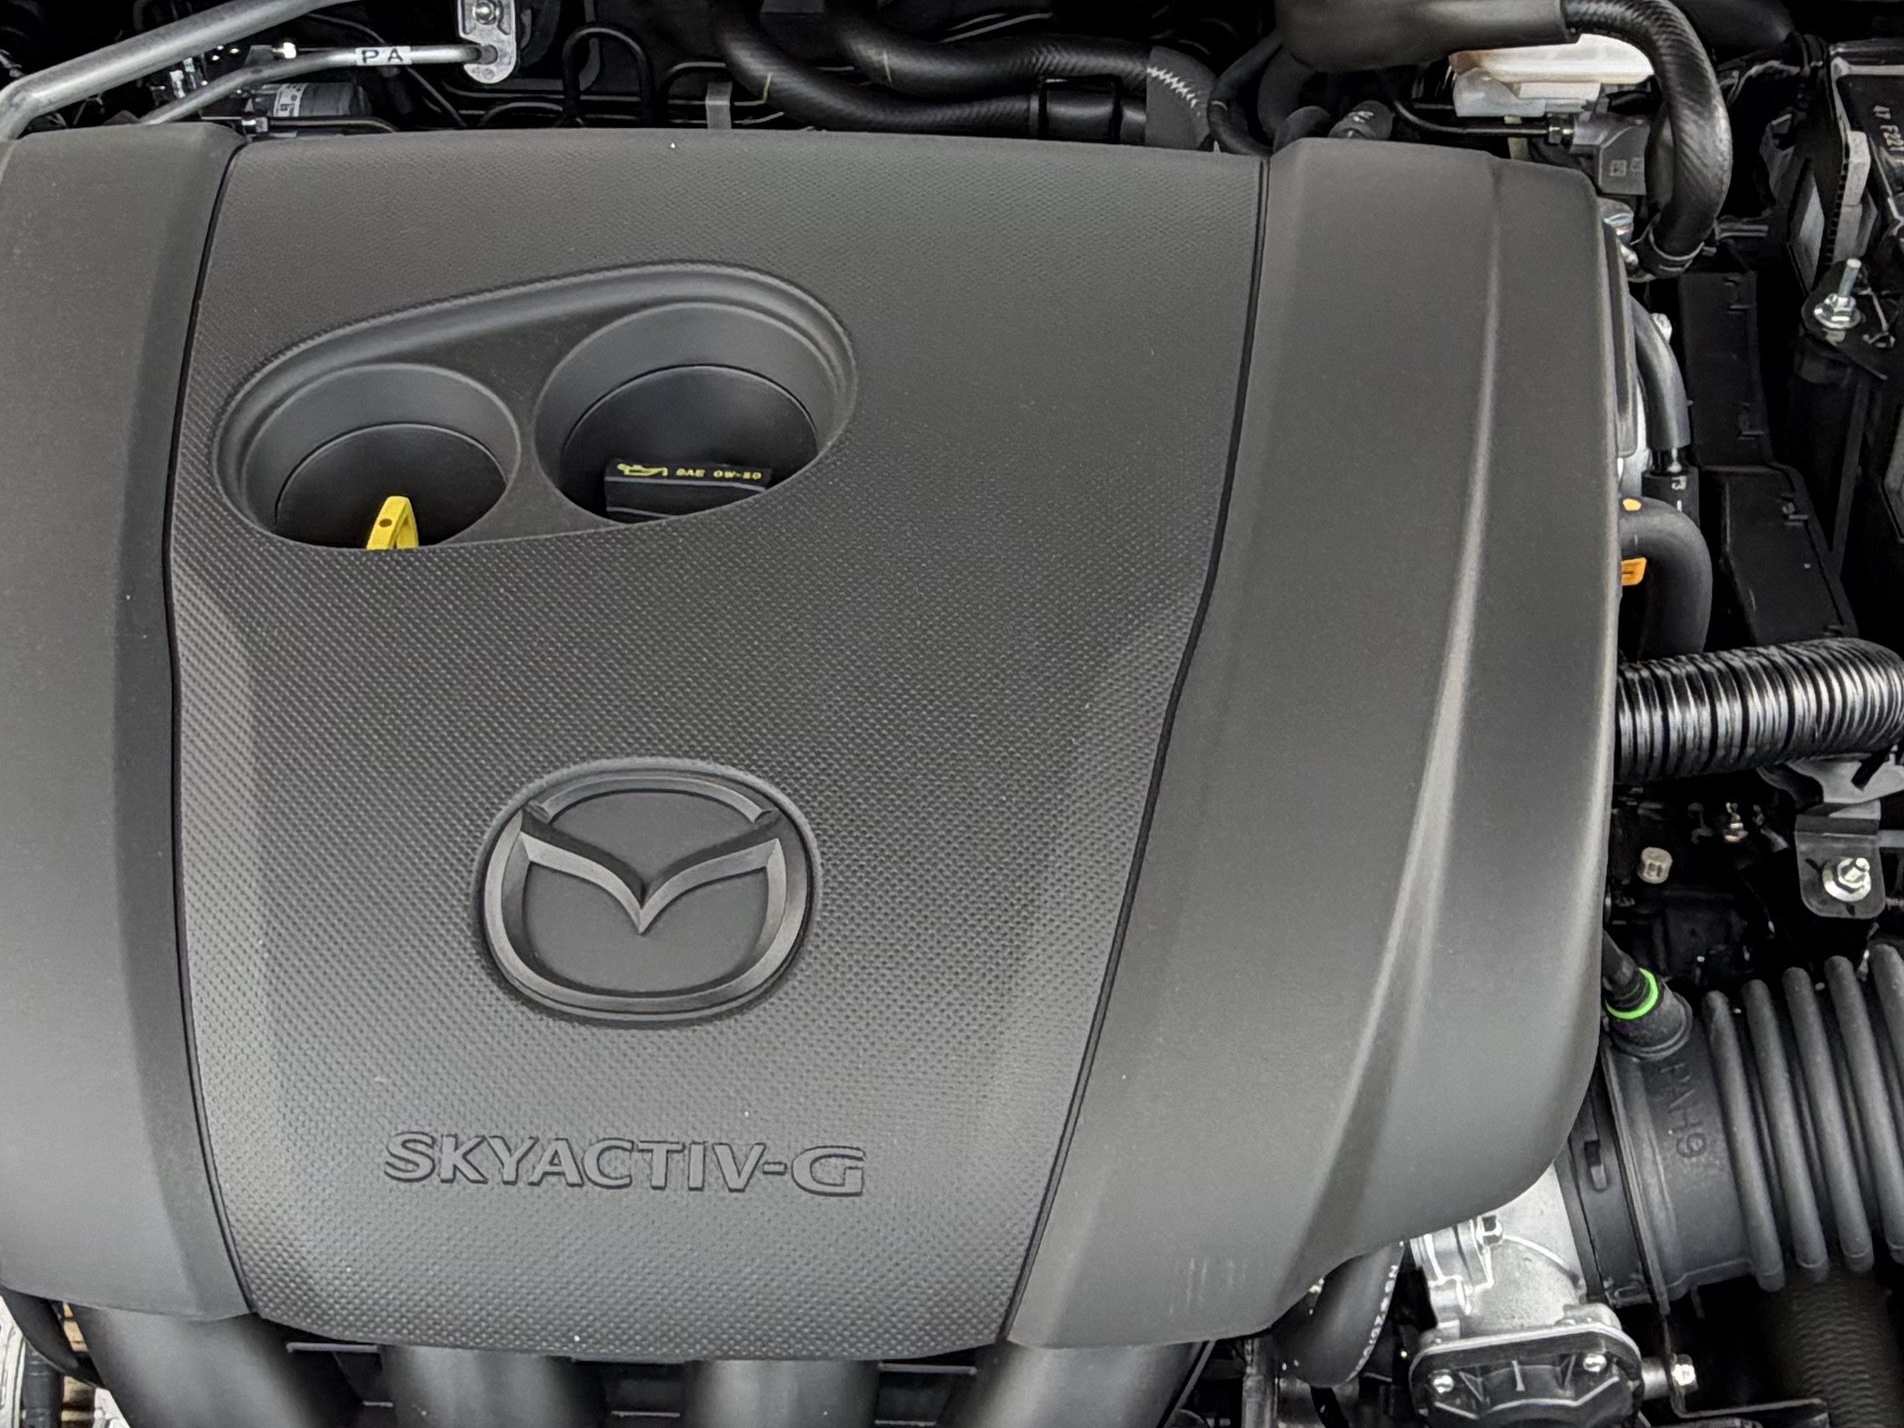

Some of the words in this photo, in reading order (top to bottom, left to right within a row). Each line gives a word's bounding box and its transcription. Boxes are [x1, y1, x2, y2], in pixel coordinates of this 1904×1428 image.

[360, 47, 405, 65] PA
[675, 467, 705, 478] SAE
[383, 1129, 867, 1198] SKYACTIV-G
